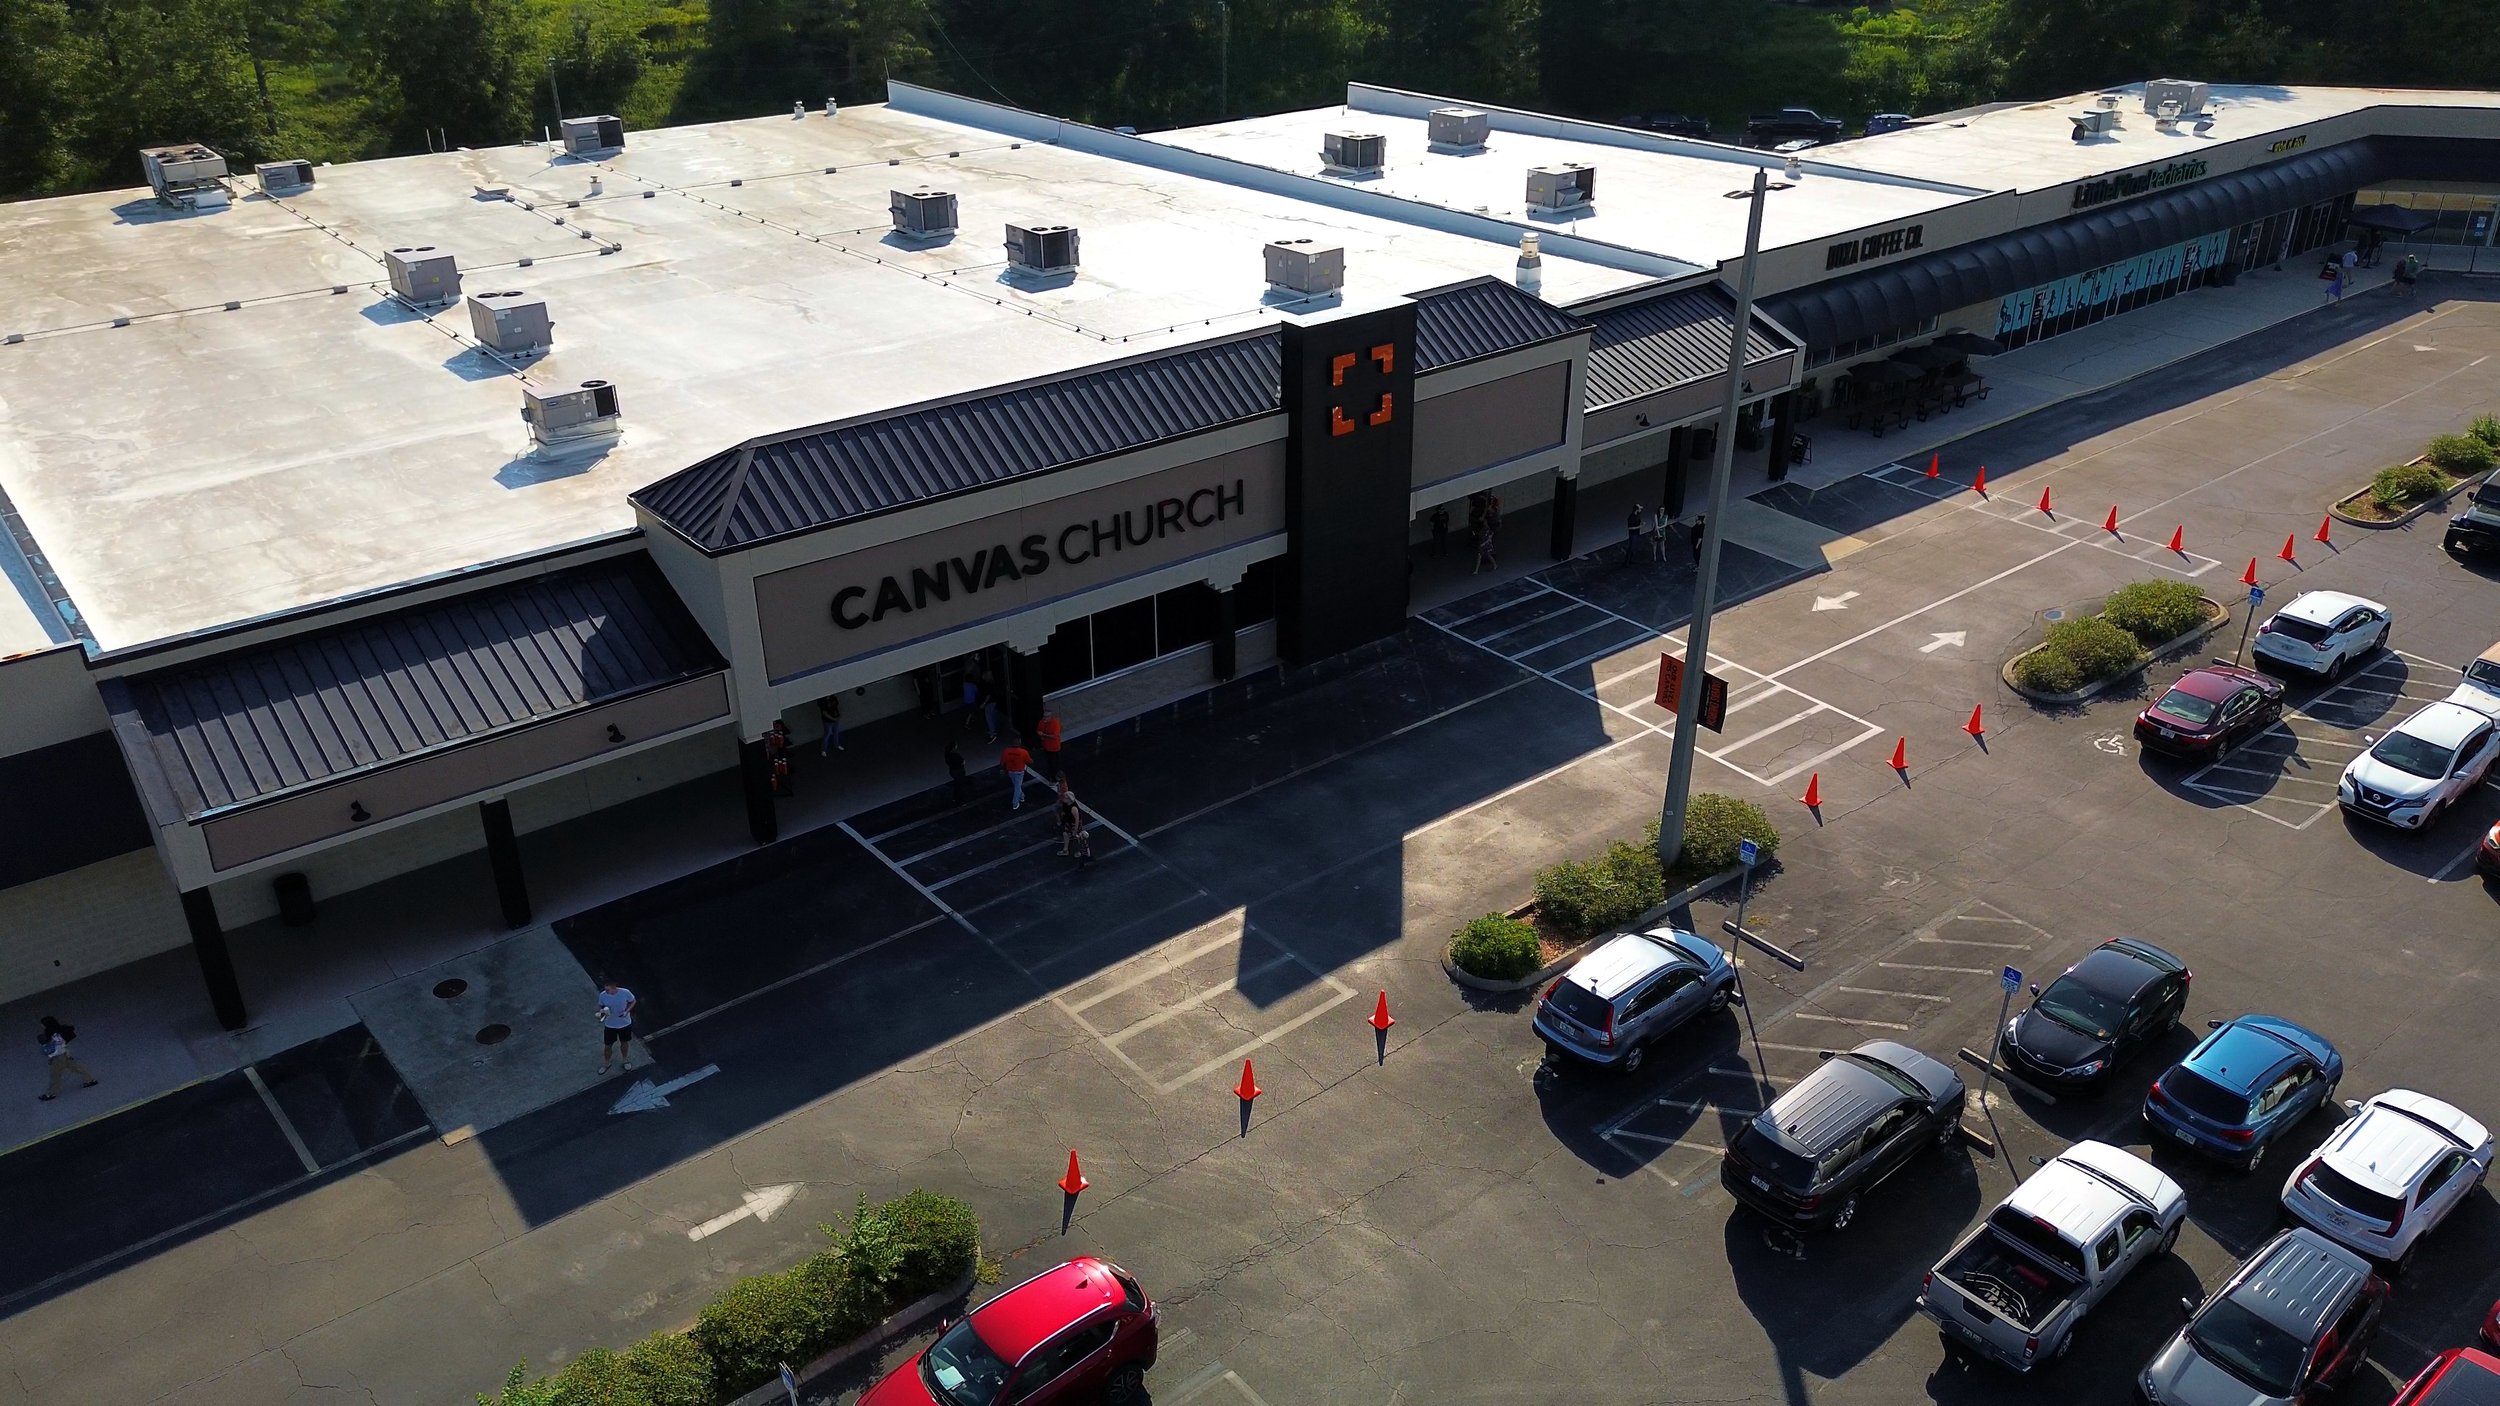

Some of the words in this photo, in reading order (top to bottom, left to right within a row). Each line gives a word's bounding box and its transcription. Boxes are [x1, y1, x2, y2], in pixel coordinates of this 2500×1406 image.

[2149, 158, 2208, 189] Pediatrics
[1860, 228, 1906, 262] COFFEE
[830, 535, 1051, 631] CANVAS
[1058, 479, 1245, 565] CHURCH
